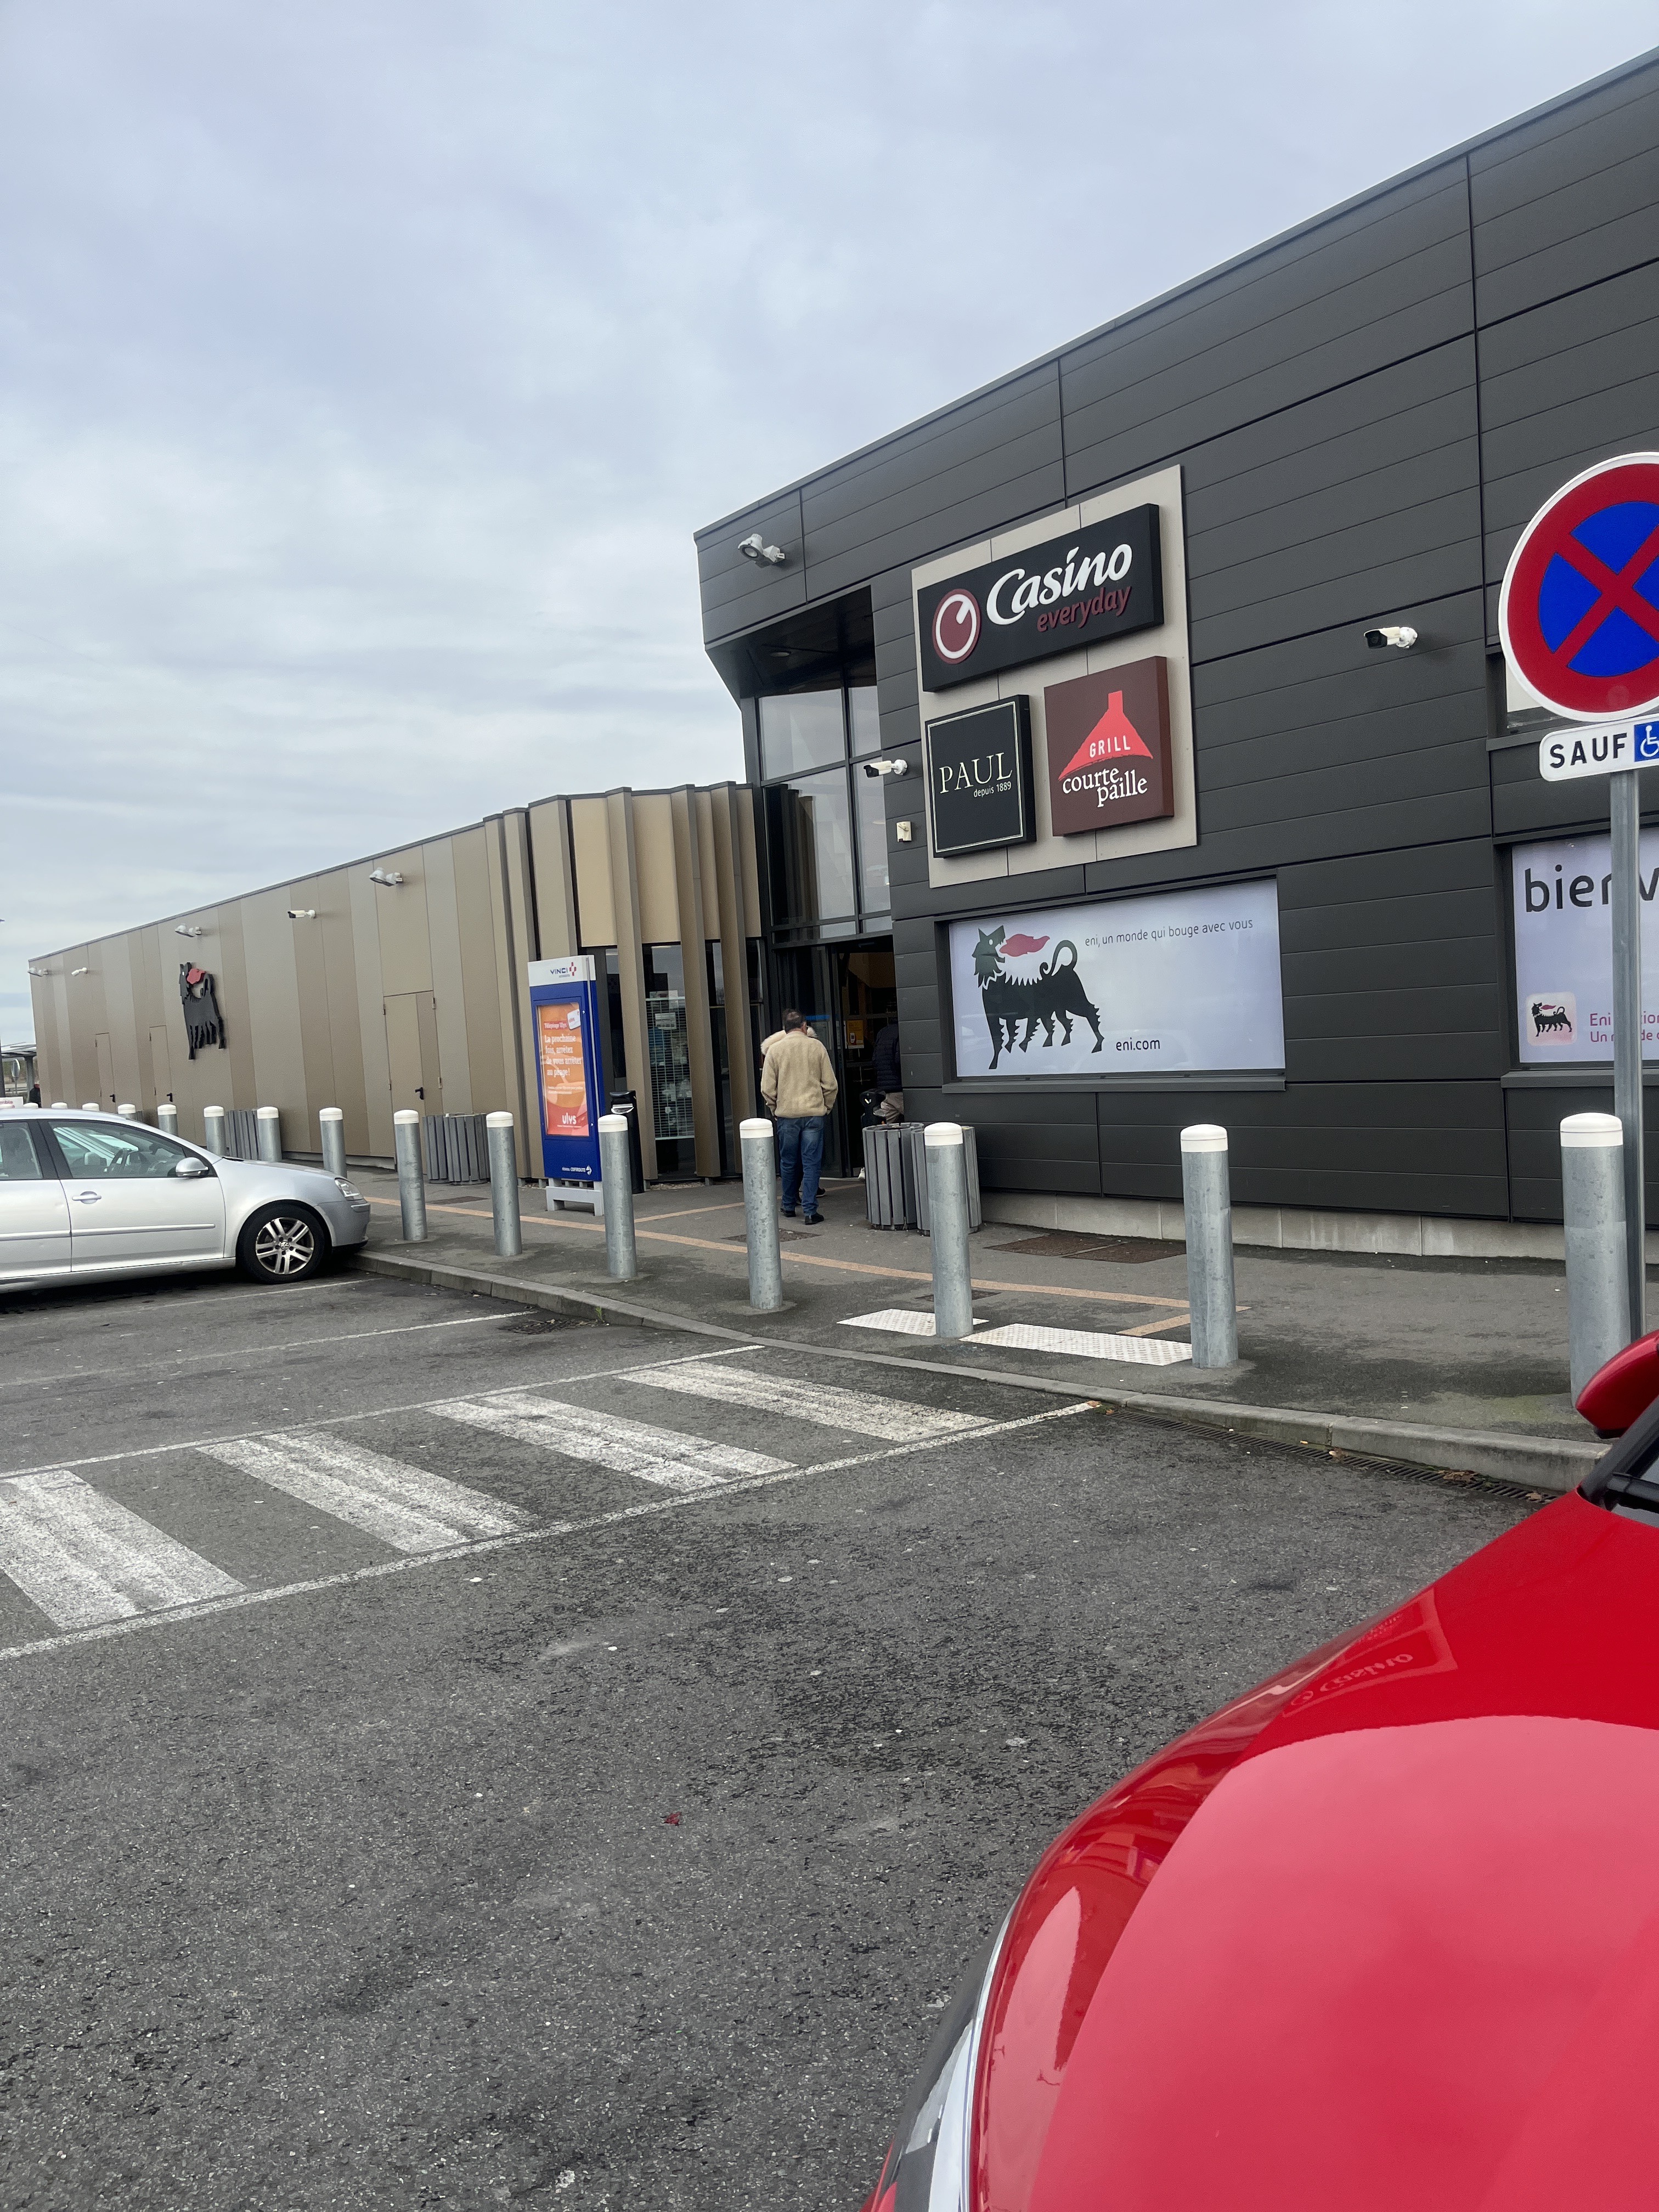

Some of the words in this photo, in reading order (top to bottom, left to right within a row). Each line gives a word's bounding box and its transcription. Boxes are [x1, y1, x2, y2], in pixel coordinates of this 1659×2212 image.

[986, 544, 1132, 625] Casino
[1037, 586, 1132, 632] everyday
[1089, 735, 1131, 758] GRILL
[1550, 732, 1628, 769] SAUF
[939, 752, 1013, 794] PAUL
[1063, 768, 1120, 794] courte
[973, 785, 995, 798] depuis
[996, 781, 1012, 793] 1889
[1097, 769, 1148, 808] paille
[1085, 934, 1101, 948] eni,
[1102, 935, 1114, 945] un
[1116, 929, 1148, 943] monde
[1151, 926, 1166, 941] qui
[1169, 925, 1199, 938] bouge
[1202, 922, 1226, 933] avec
[1229, 919, 1253, 930] vous
[1590, 1012, 1611, 1026] Eni
[544, 1035, 551, 1043] La
[551, 1033, 576, 1045] prochaine
[1116, 1037, 1160, 1051] eni.com
[1590, 1031, 1607, 1042] Un
[546, 1056, 552, 1064] de
[562, 1112, 577, 1125] ulys
